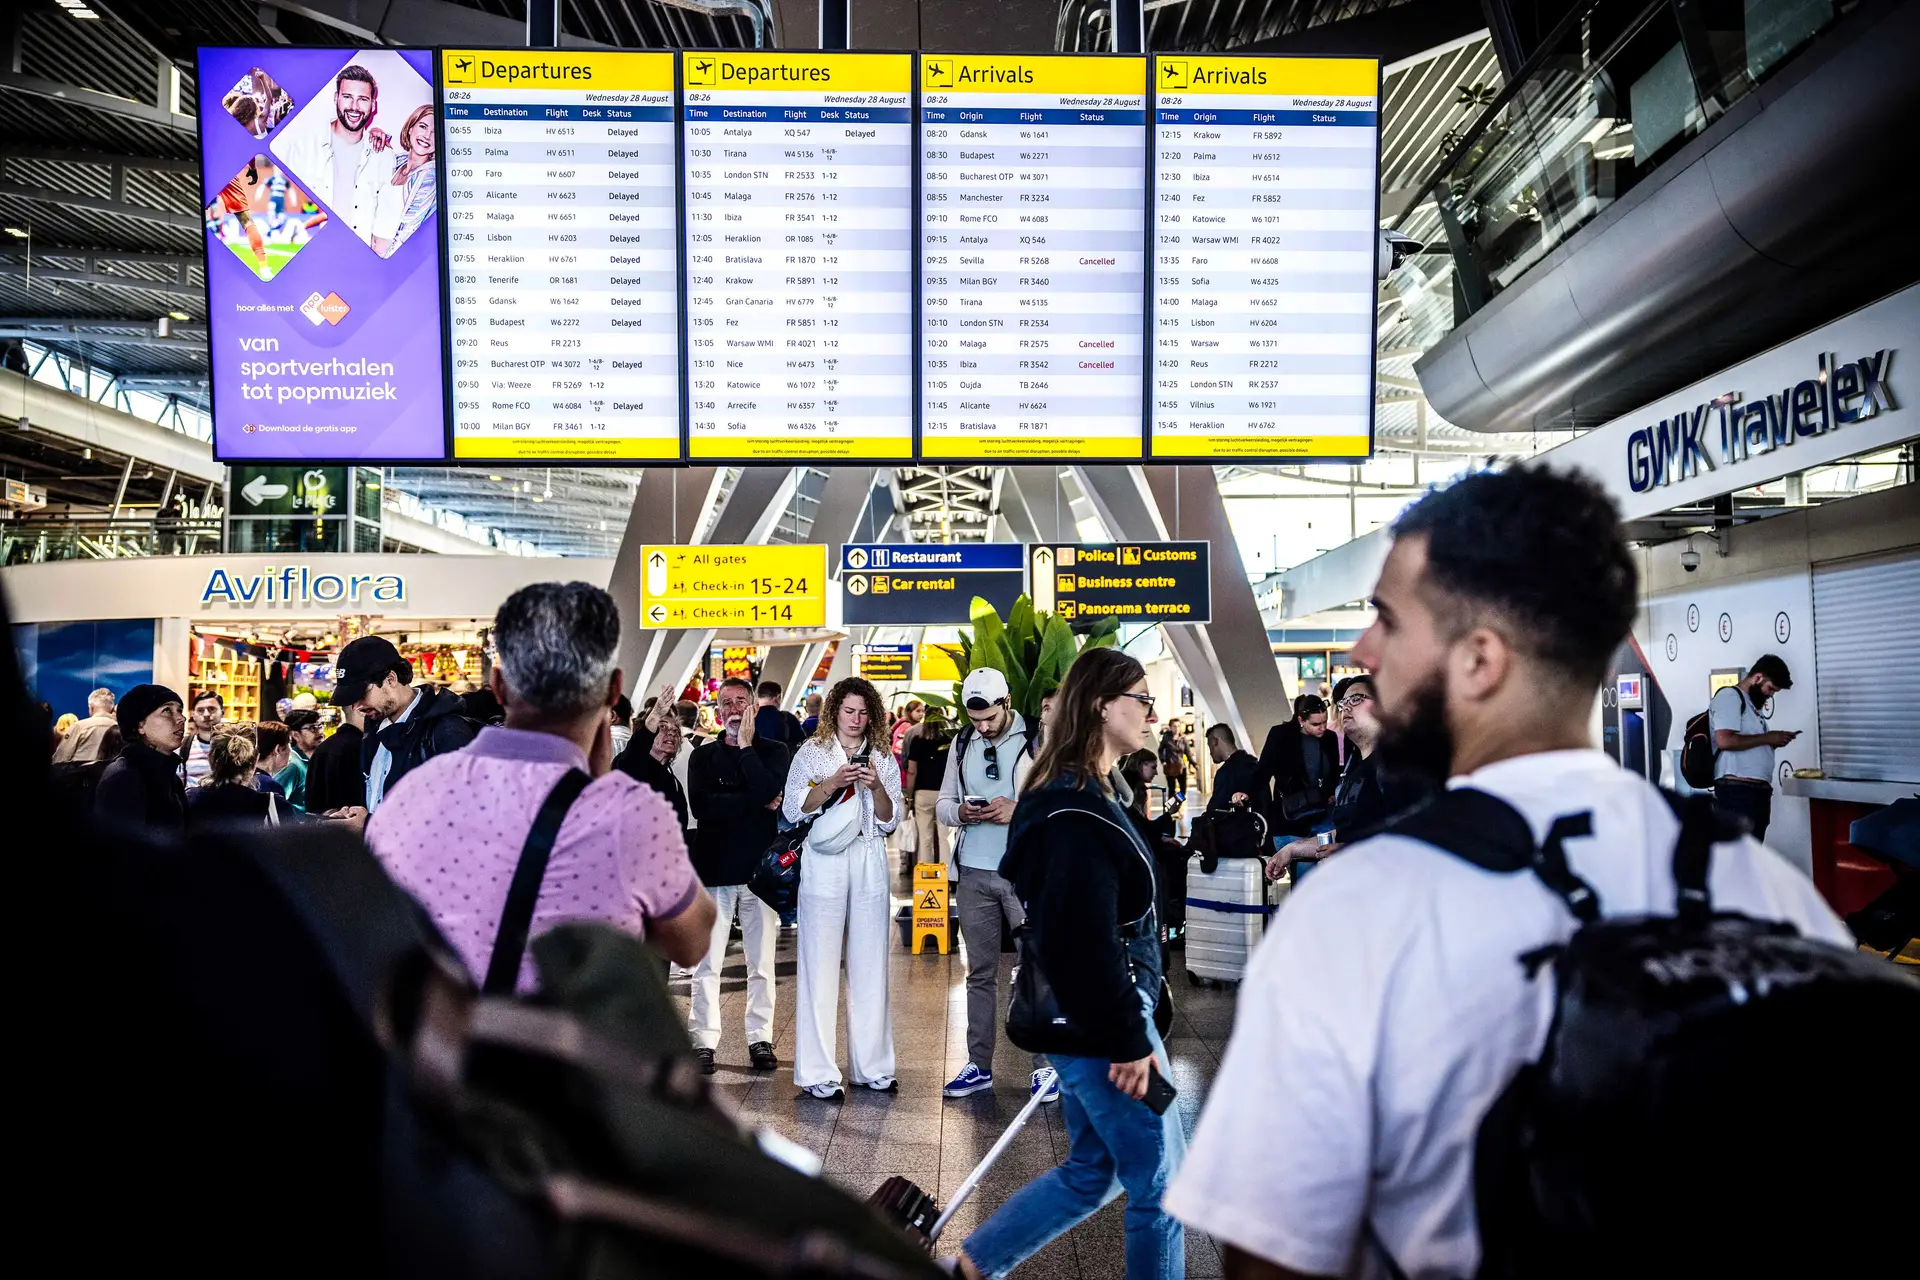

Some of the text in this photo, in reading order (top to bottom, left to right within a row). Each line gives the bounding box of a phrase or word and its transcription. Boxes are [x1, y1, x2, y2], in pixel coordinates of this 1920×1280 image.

[481, 60, 592, 83] Departures
[721, 62, 831, 85] Departures
[958, 65, 1034, 84] Arrivals
[1192, 66, 1267, 85] Arrivals
[449, 91, 669, 104] 08:26 Wednesday 28 August
[689, 93, 906, 106] 08:26 Wednesday 28 August
[926, 95, 1141, 108] 08:26 Wednesday 28 August
[1161, 96, 1372, 109] 08:26 Wednesday 28 August
[449, 107, 632, 119] Time Destination Flight Desk Status
[688, 109, 870, 120] Time Destination Flight Desk Status
[926, 111, 1105, 123] Time Origin Flight Status
[1160, 112, 1337, 124] Time Origin Flight Status
[449, 126, 639, 138] 06:55 Ibiza HV 6513 Delayed
[1161, 130, 1283, 140] 12:15 Krakow FR 5892
[691, 170, 712, 179] 10:35
[724, 170, 752, 179] London
[753, 170, 769, 179] STN
[784, 171, 795, 180] FR
[796, 171, 815, 180] 2533
[926, 193, 1050, 203] 08:55 Manchester FR 3234
[453, 233, 475, 242] 07:45
[487, 233, 512, 242] Lisbon
[609, 234, 640, 244] Delayed
[1160, 235, 1181, 244] 12:40
[1251, 236, 1261, 245] FR
[1262, 236, 1281, 245] 4022
[926, 256, 1116, 266] 09:25 Sevilla FR 5268 Cancelled
[692, 276, 714, 285] 12:40
[725, 276, 754, 285] Krakow
[785, 276, 796, 285] FR
[797, 276, 815, 285] 5891
[236, 304, 256, 312] hoor
[256, 303, 276, 312] alles
[302, 294, 320, 313] npo
[320, 304, 347, 313] luister
[693, 318, 714, 327] 13:05
[726, 318, 739, 327] Fez
[786, 318, 797, 327] FR
[797, 318, 816, 327] 5851
[238, 337, 279, 352] van
[241, 357, 394, 380] sportverhalen
[927, 360, 1115, 369] 10:35 Ibiza FR 3542 Cancelled
[457, 380, 480, 389] 09:50
[491, 381, 506, 389] Via:
[507, 381, 532, 389] Weeze
[552, 381, 562, 389] FR
[563, 381, 583, 389] 5269
[241, 381, 398, 405] tot popmuziek
[694, 401, 716, 410] 13:40
[727, 401, 757, 410] Arrecife
[1158, 400, 1178, 409] 14:55
[1189, 400, 1215, 409] Vilnius
[1627, 348, 1900, 494] GWK Travelex
[258, 424, 301, 432] Download
[302, 424, 314, 432] de
[314, 424, 339, 434] gratis
[693, 554, 747, 567] All gates
[892, 551, 962, 563] Restaurant
[1077, 549, 1115, 562] Police
[1143, 549, 1197, 562] Customs
[200, 565, 407, 603] Aviflora
[693, 577, 808, 595] Check-in 15-24
[892, 577, 955, 590] Car rental
[1078, 575, 1176, 589] Business centre
[693, 604, 793, 621] Check-in 1-14
[1078, 602, 1191, 615] Panorama terrace
